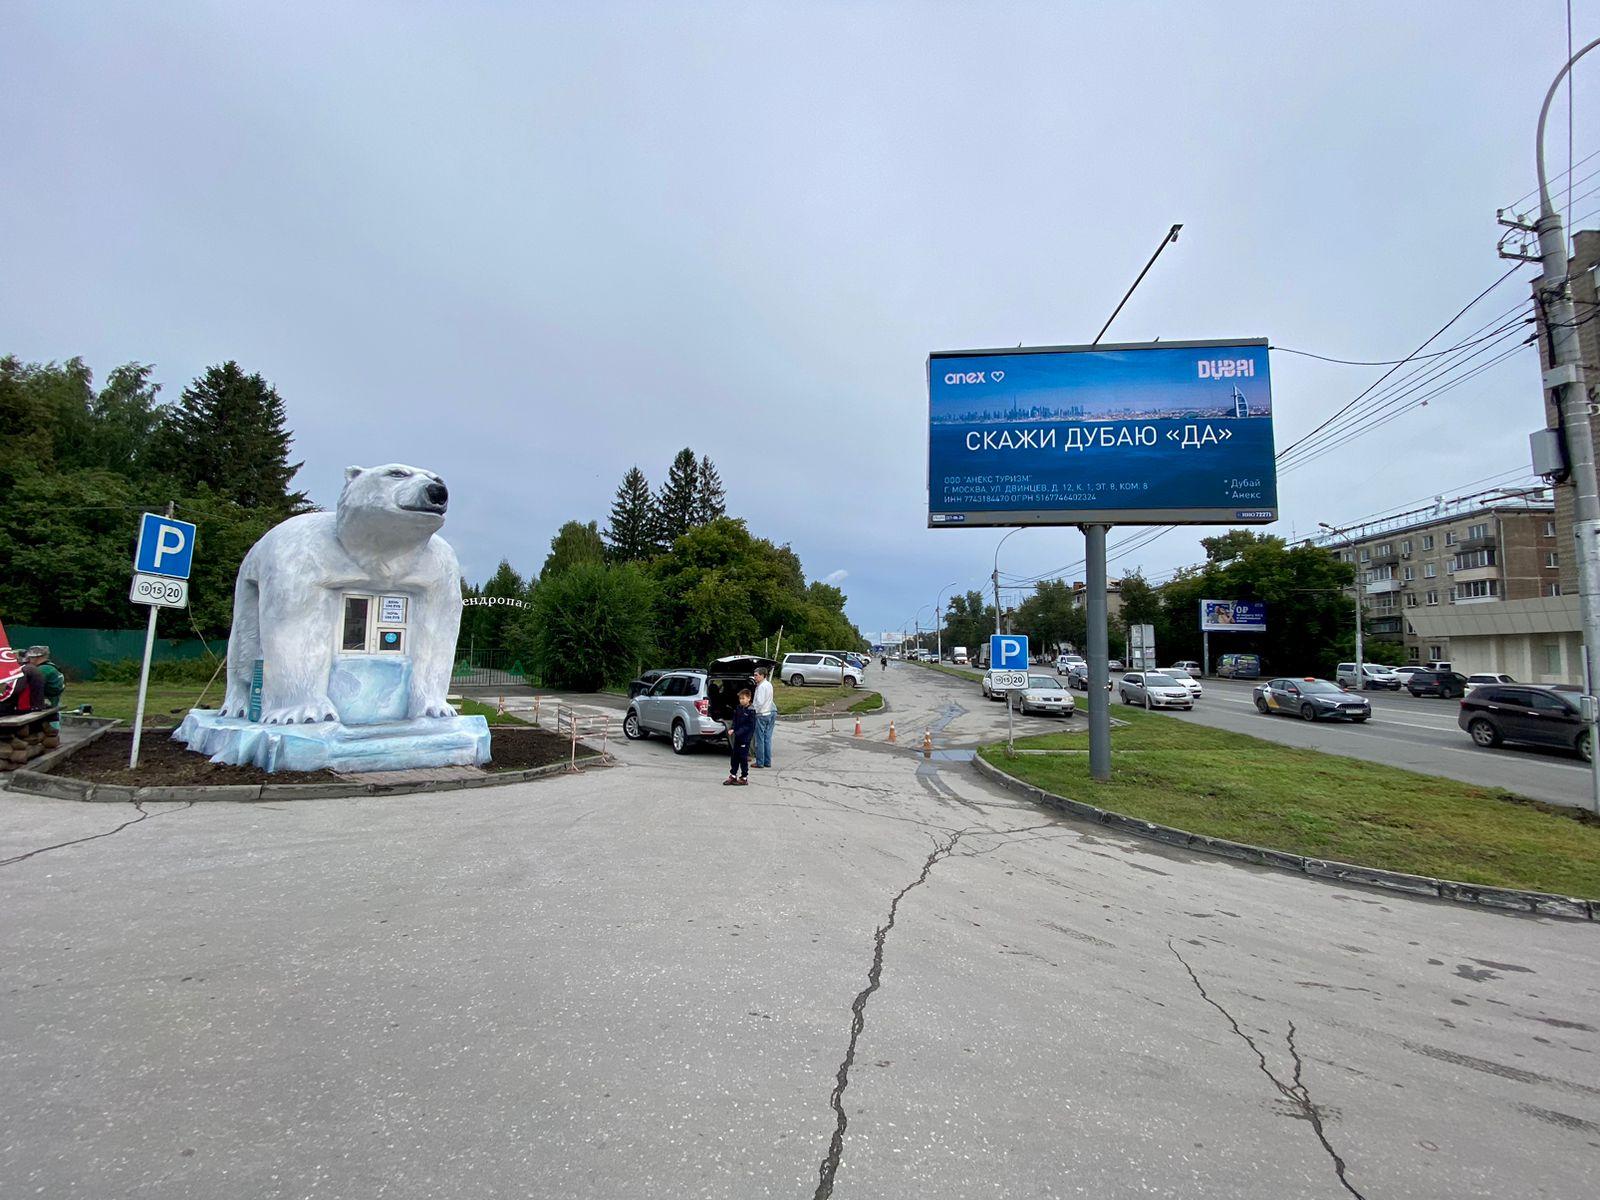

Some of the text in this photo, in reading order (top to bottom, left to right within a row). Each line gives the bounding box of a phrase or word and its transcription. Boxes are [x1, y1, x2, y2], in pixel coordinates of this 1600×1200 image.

[1197, 358, 1255, 380] DUBAI
[944, 370, 986, 385] anex
[965, 424, 1233, 452] СКАЖИ ДУБАЮ «ДА»
[944, 476, 961, 484] ООО
[1230, 478, 1261, 489] Дубай
[1011, 494, 1034, 502] ОГРН
[1231, 490, 1262, 499] Анекс
[154, 524, 185, 567] P
[152, 586, 162, 594] 15
[167, 587, 179, 597] 20
[1001, 640, 1020, 665] P
